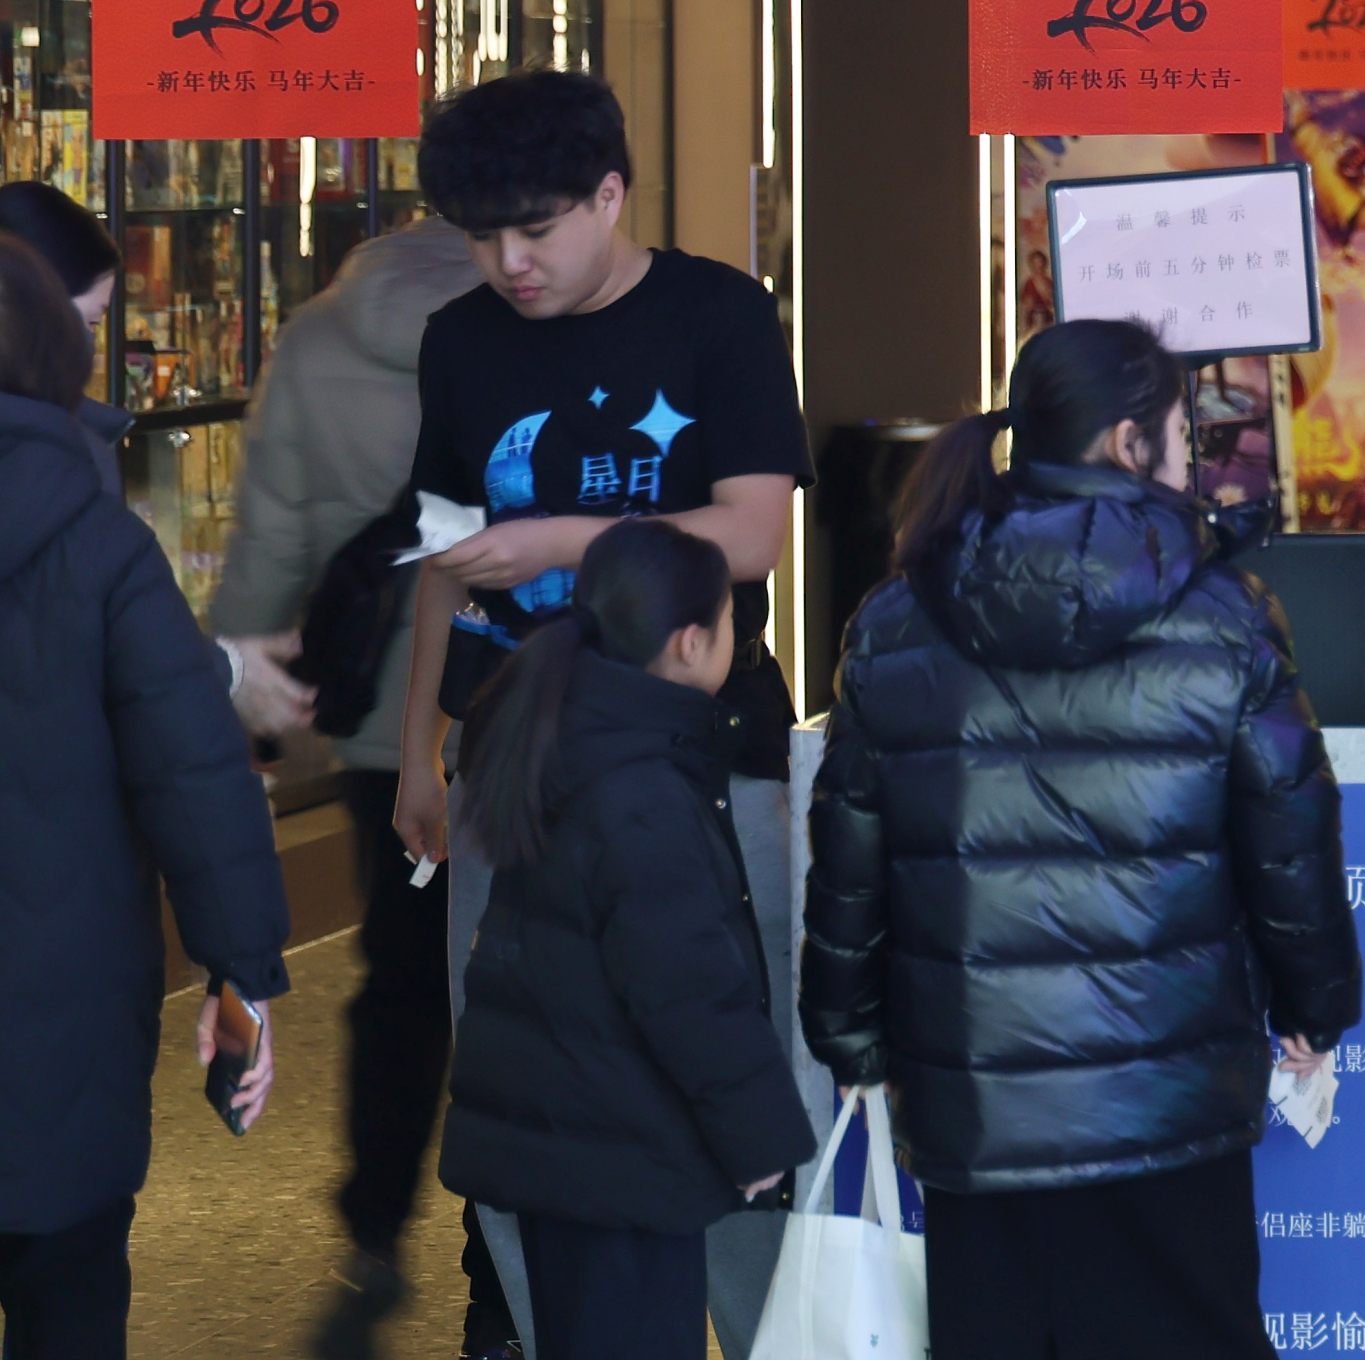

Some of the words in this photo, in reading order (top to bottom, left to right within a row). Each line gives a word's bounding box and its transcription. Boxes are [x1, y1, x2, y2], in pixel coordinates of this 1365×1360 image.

[1116, 204, 1246, 231] 温馨提示
[1079, 250, 1291, 282] 开场前五分钟检票
